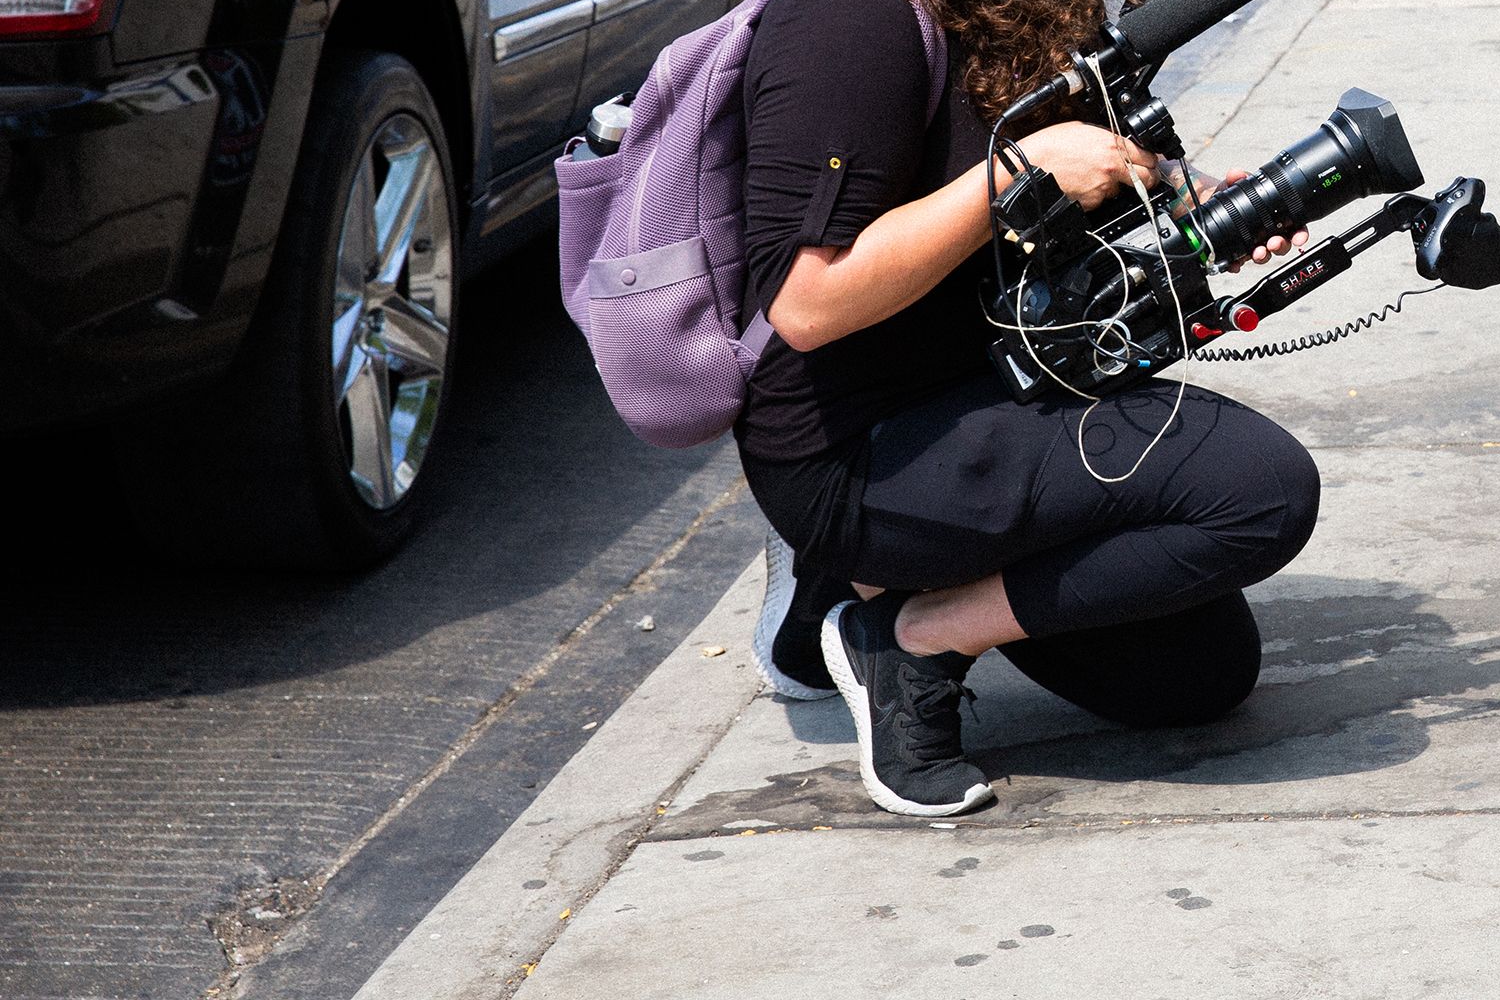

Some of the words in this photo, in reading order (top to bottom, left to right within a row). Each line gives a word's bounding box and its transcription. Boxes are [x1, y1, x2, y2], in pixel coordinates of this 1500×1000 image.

[1322, 172, 1342, 188] 18-55
[1423, 226, 1438, 248] SONY
[1280, 260, 1325, 291] SHAPE
